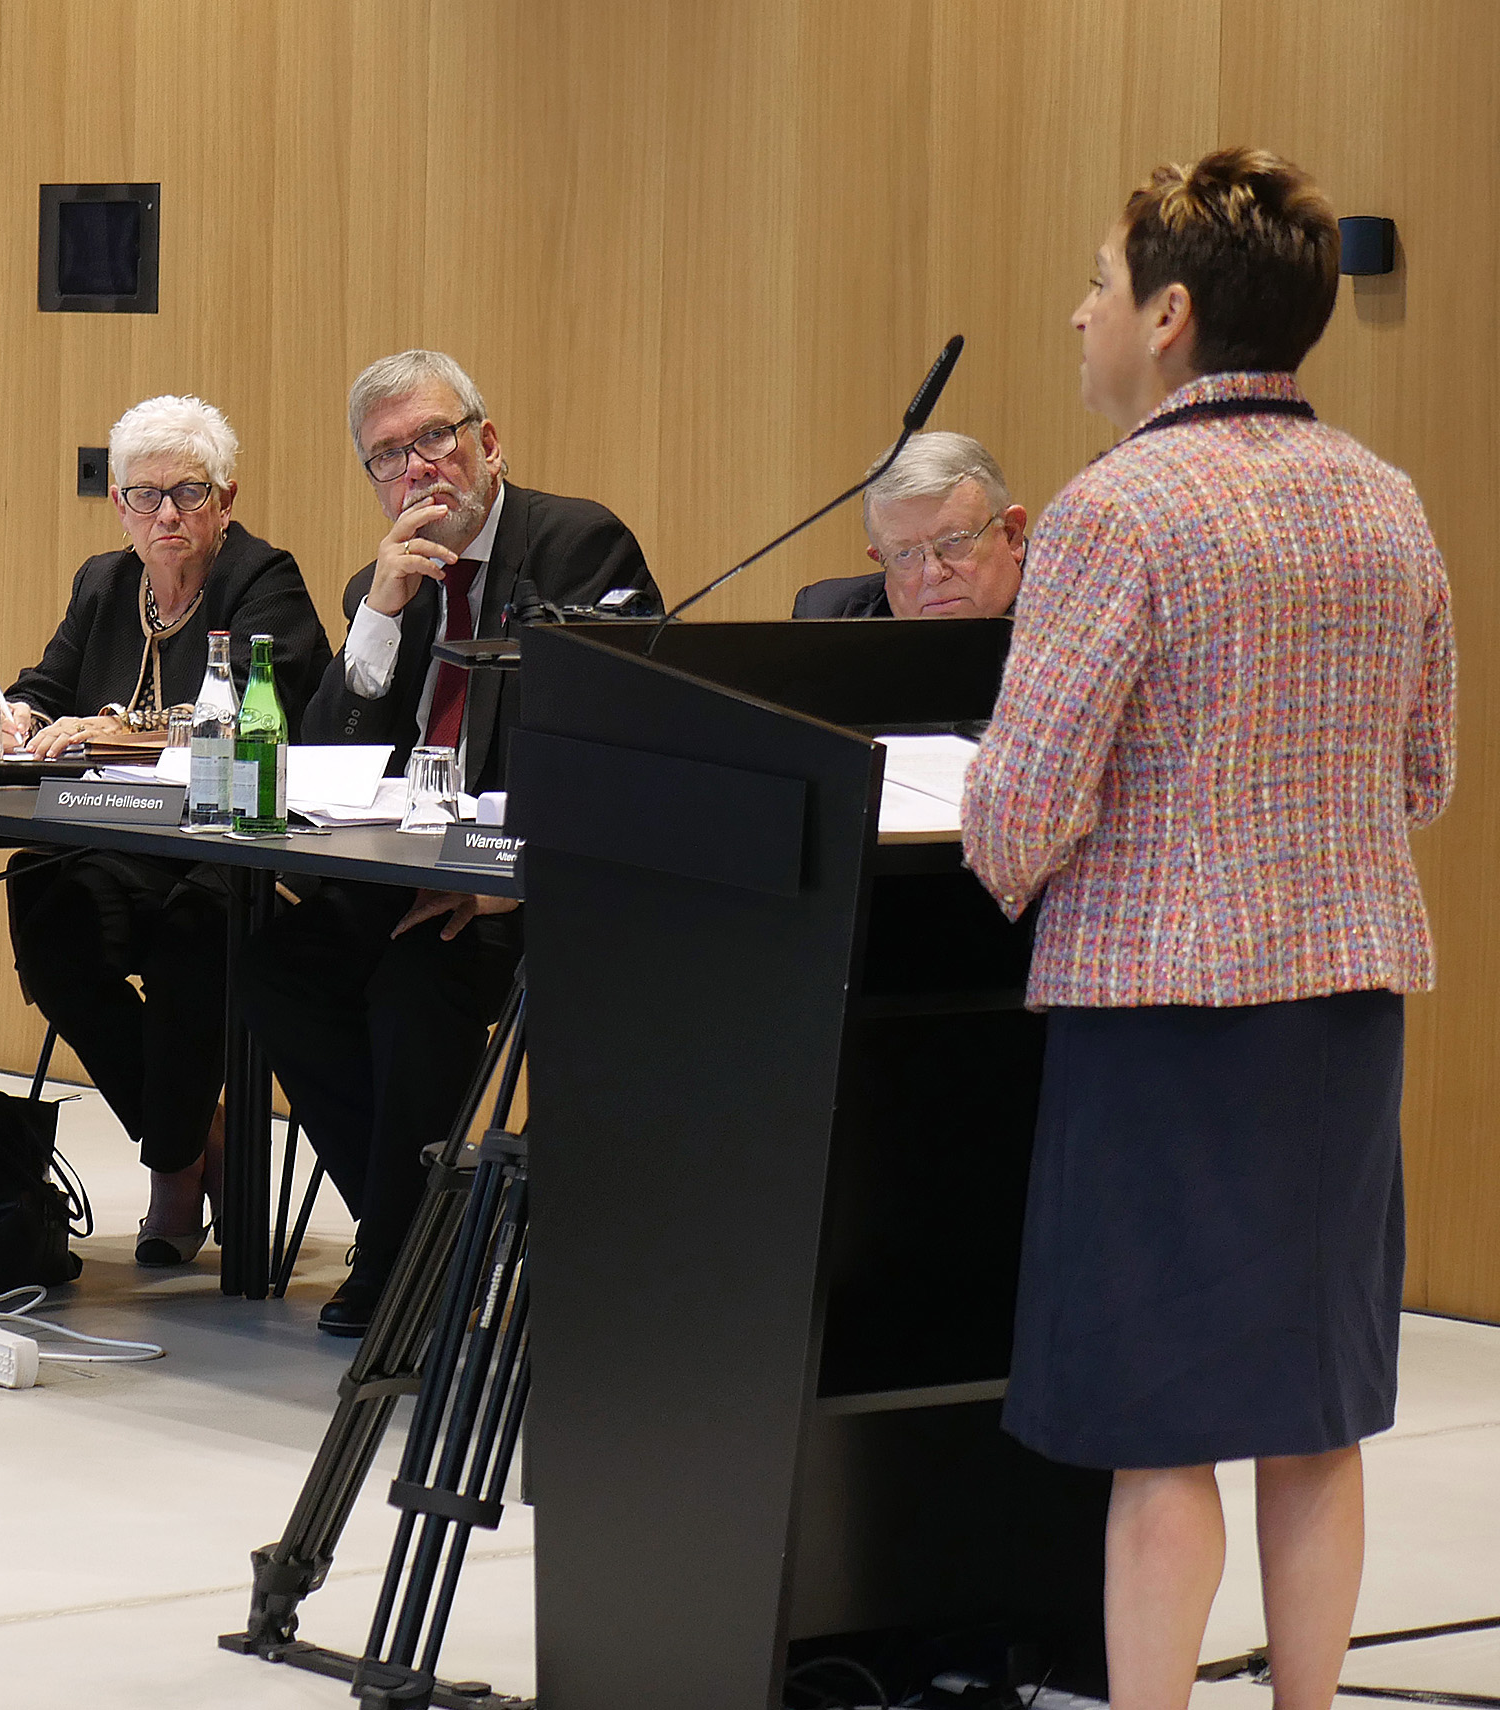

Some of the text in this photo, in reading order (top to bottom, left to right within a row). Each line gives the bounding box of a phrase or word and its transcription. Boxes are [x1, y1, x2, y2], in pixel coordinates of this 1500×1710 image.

[58, 791, 164, 810] Øyvind Helliesen
[465, 833, 512, 850] Warren
[480, 1263, 504, 1330] Manfrotto
